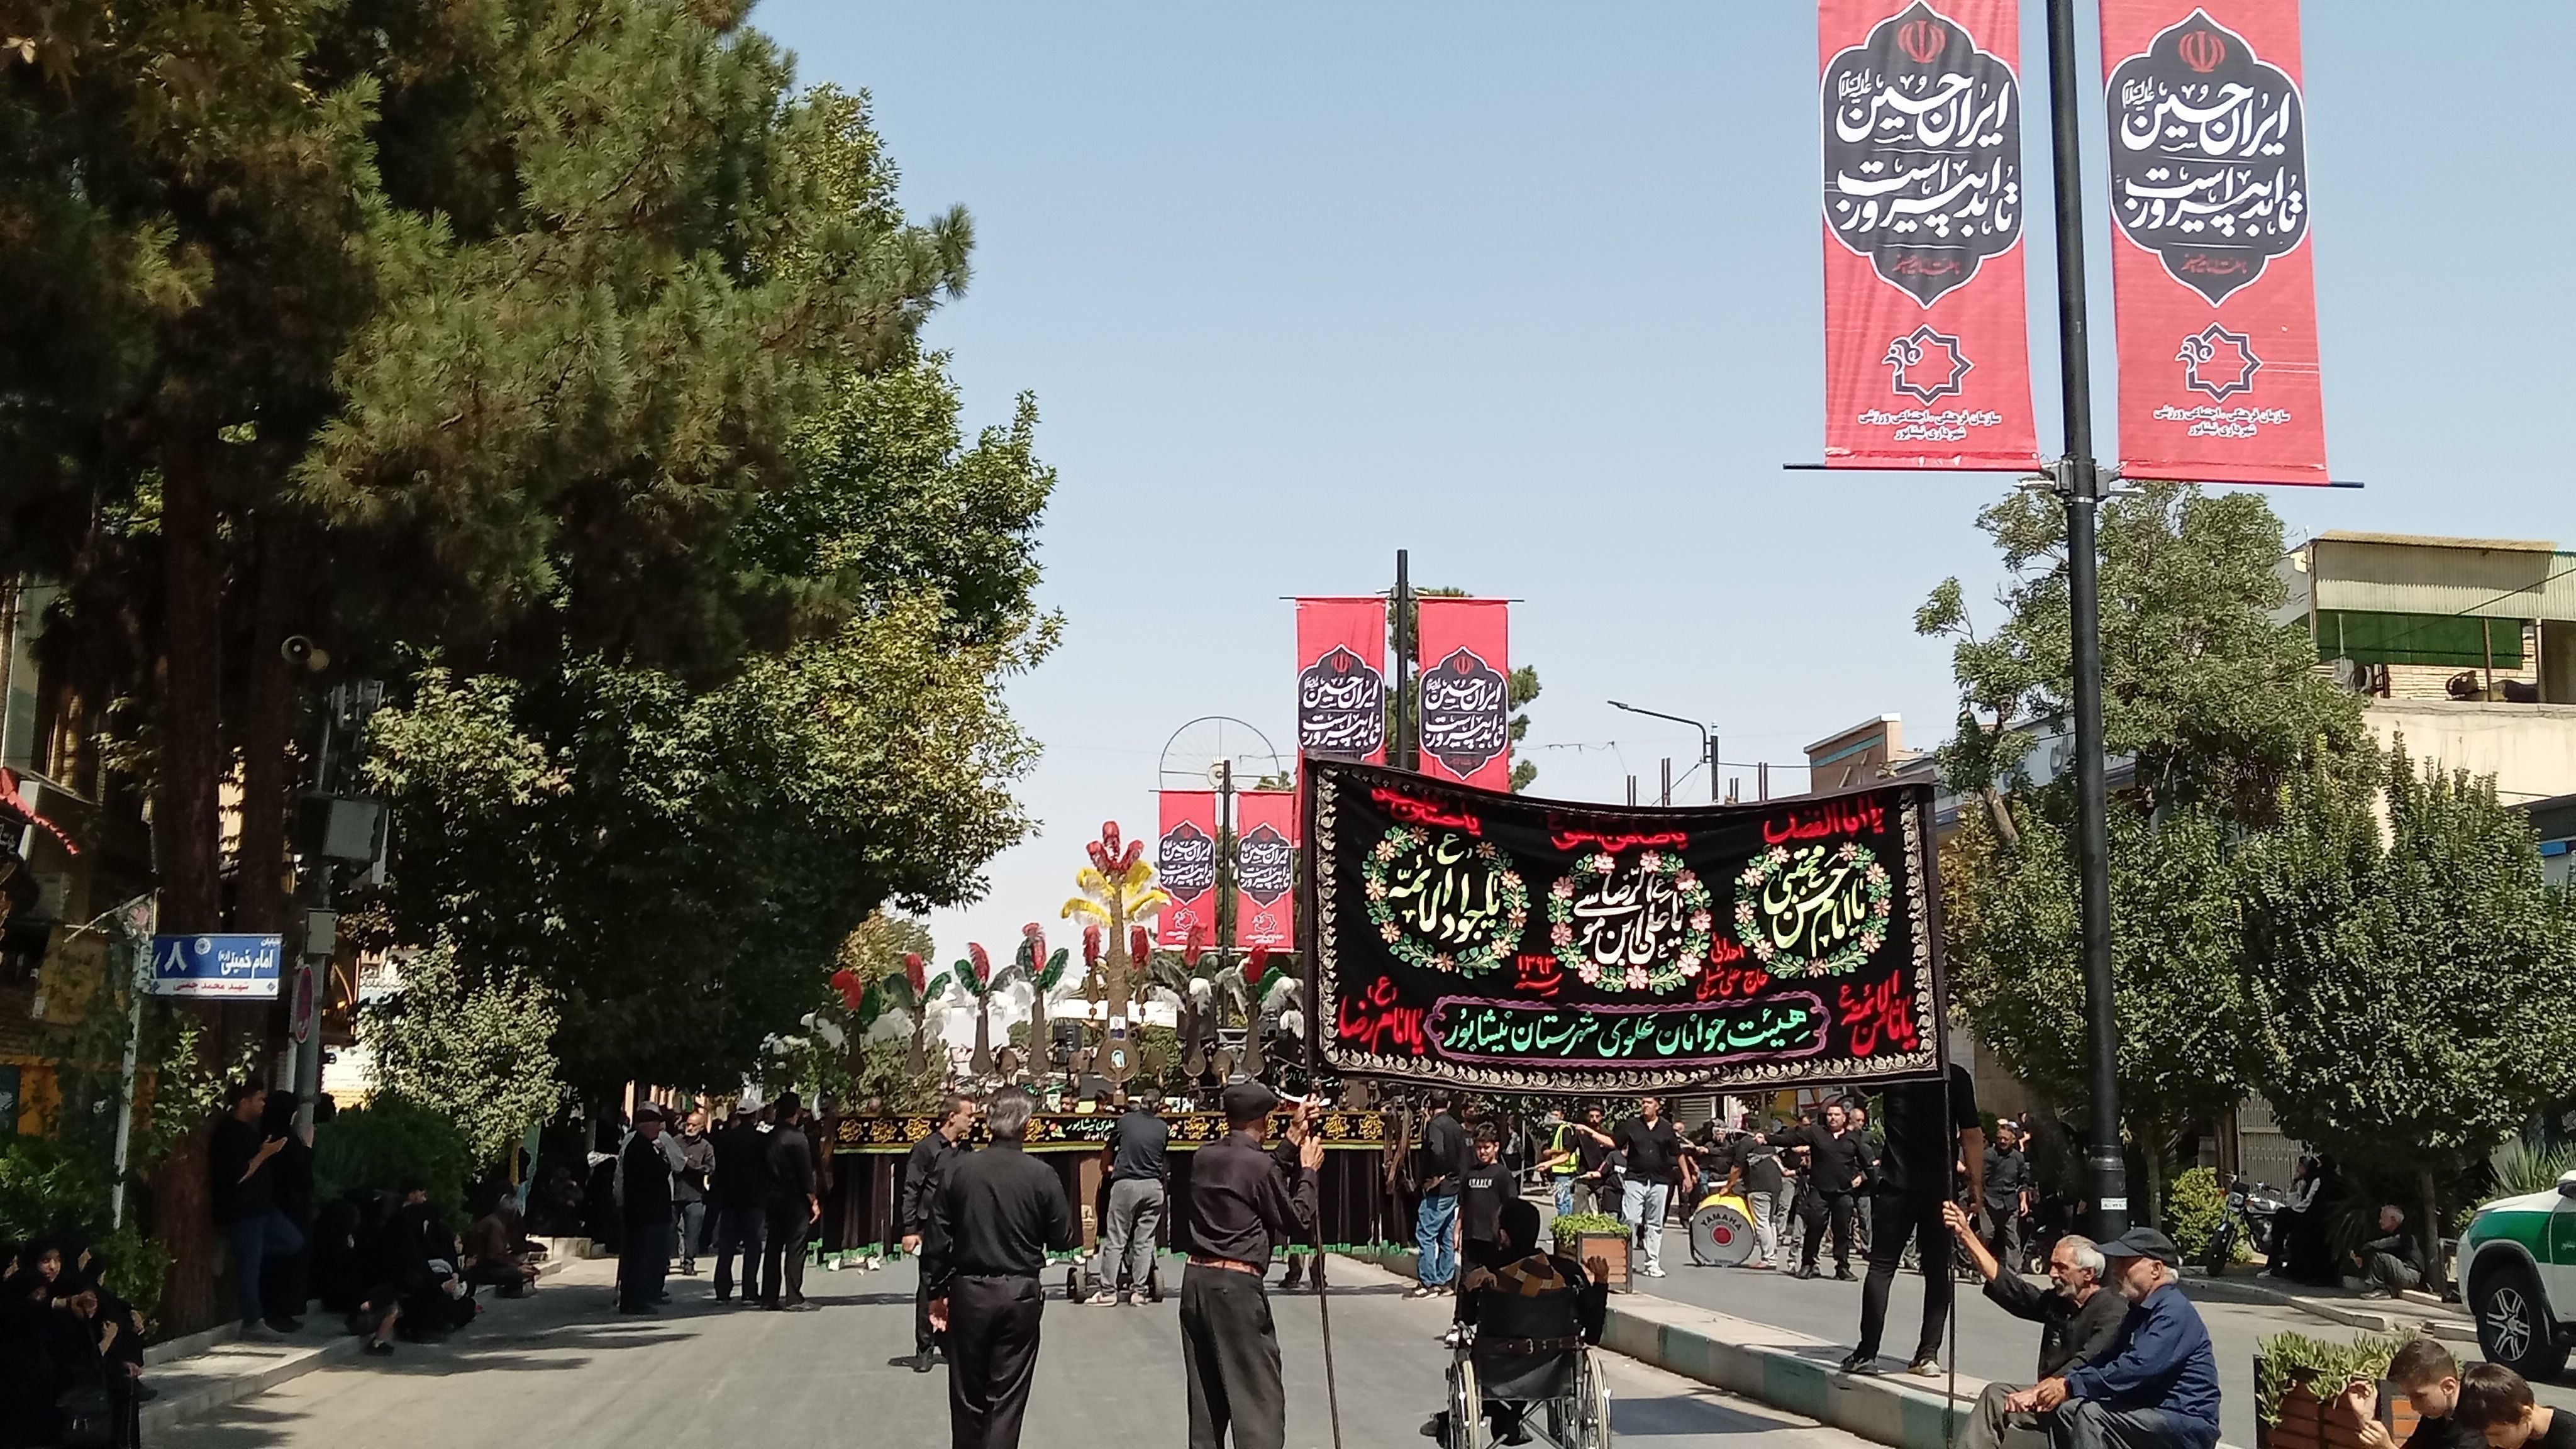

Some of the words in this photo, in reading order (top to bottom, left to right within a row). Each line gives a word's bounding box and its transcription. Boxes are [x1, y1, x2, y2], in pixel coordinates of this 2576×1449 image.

[1836, 73, 1974, 143] حسین
[1916, 82, 2010, 148] ایران
[2121, 83, 2254, 150] حسین
[2199, 92, 2291, 157] ایران
[1836, 157, 1951, 196] است
[2125, 167, 2233, 199] است
[1970, 410, 2001, 425] سازمان
[2219, 423, 2255, 436] شهرداری
[2259, 408, 2290, 423] سازمان
[1927, 426, 1966, 440] شهرداری
[1303, 676, 1364, 709] حسین
[1338, 679, 1379, 709] ایران
[1425, 678, 1486, 710] حسین
[1460, 682, 1502, 711] ایران
[1303, 713, 1352, 730] است
[1424, 715, 1475, 732] است
[1480, 871, 1501, 930] یا
[1849, 878, 1866, 936] یا
[1667, 891, 1684, 947] یا
[164, 941, 188, 972] ۸
[220, 948, 252, 976] خمینی
[252, 948, 274, 979] امام
[1518, 955, 1557, 975] ۱۳۹۳
[1743, 969, 1769, 995] حاج
[1339, 995, 1375, 1043] رضا
[1371, 1007, 1410, 1055] امام
[1411, 1008, 1424, 1055] یا
[1443, 1008, 1513, 1052] نیشابور
[1511, 1010, 1599, 1057] شهرستان
[1655, 1013, 1726, 1055] جوانان
[1901, 994, 1918, 1050] یا
[1065, 1118, 1096, 1132] نیشابور
[1700, 1213, 1742, 1231] YAMAHA
